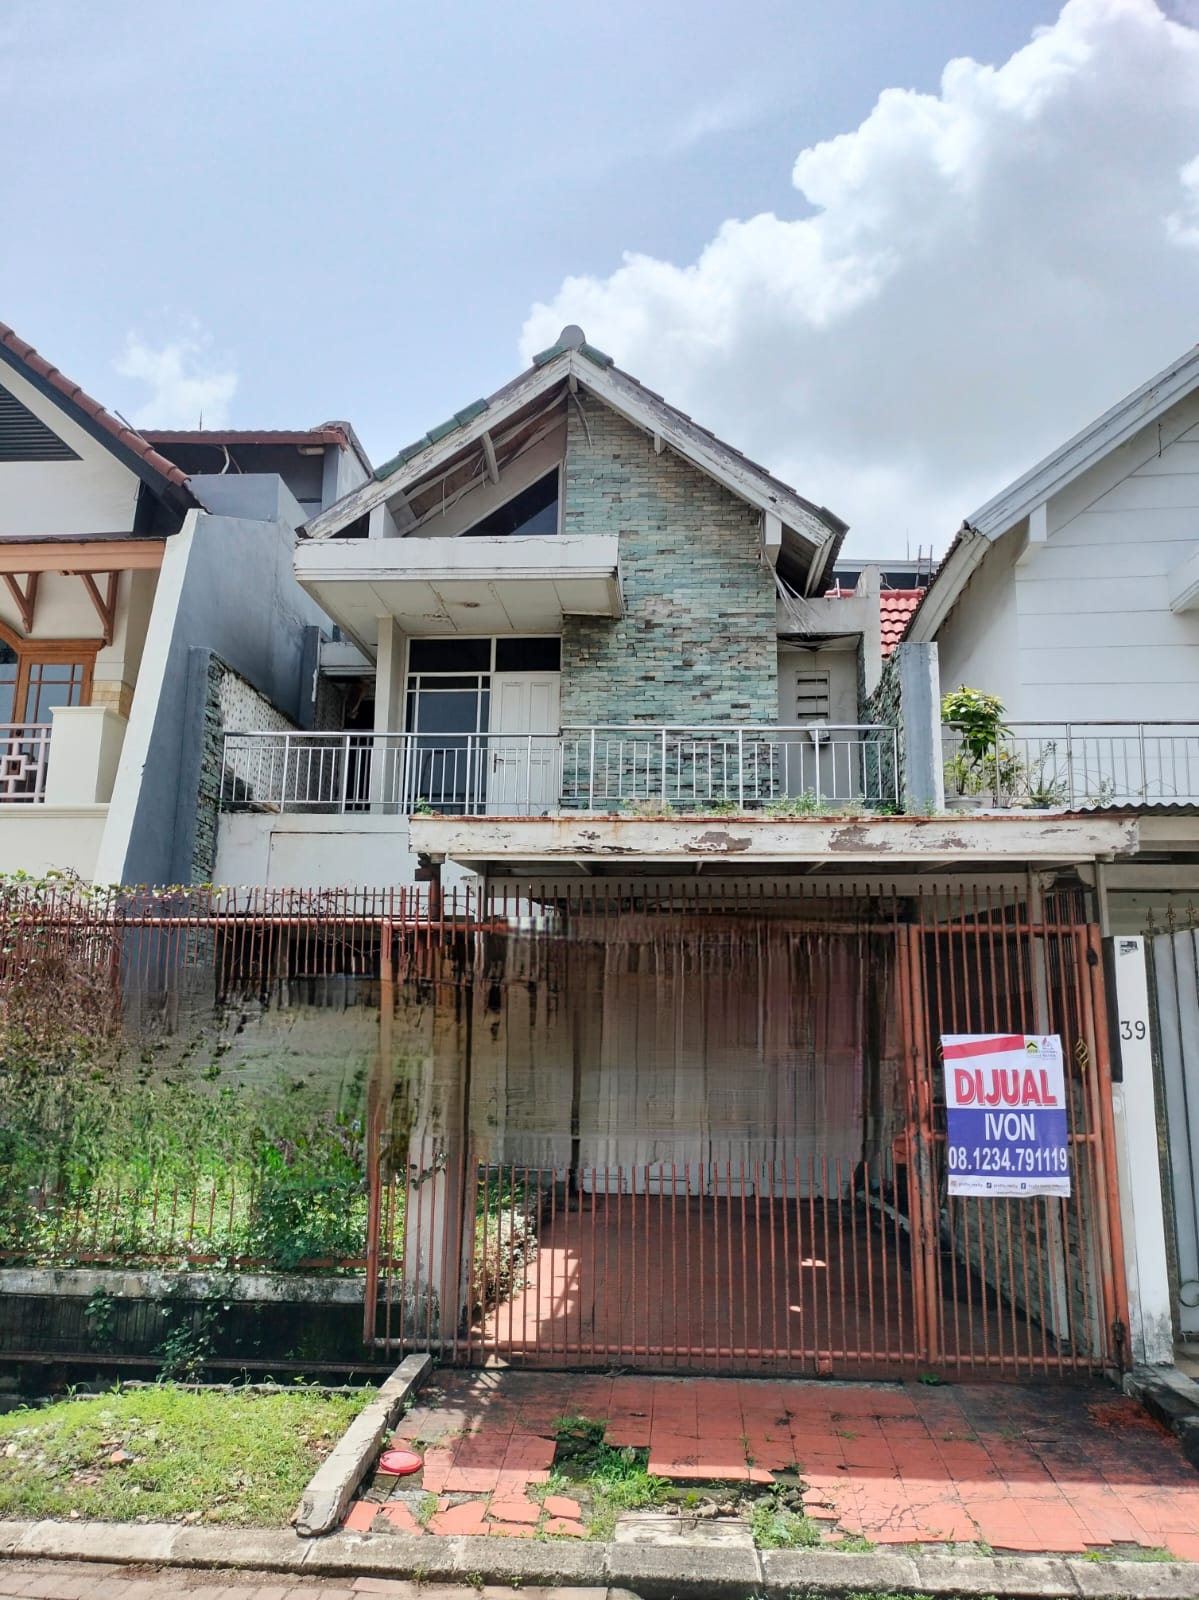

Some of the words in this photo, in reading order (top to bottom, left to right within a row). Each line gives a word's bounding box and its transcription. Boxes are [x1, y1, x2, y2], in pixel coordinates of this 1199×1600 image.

[1121, 1021, 1146, 1040] 39
[954, 1069, 1057, 1106] DIJUAL
[985, 1113, 1035, 1140] IVON
[949, 1147, 1067, 1172] 08.1234.791119
